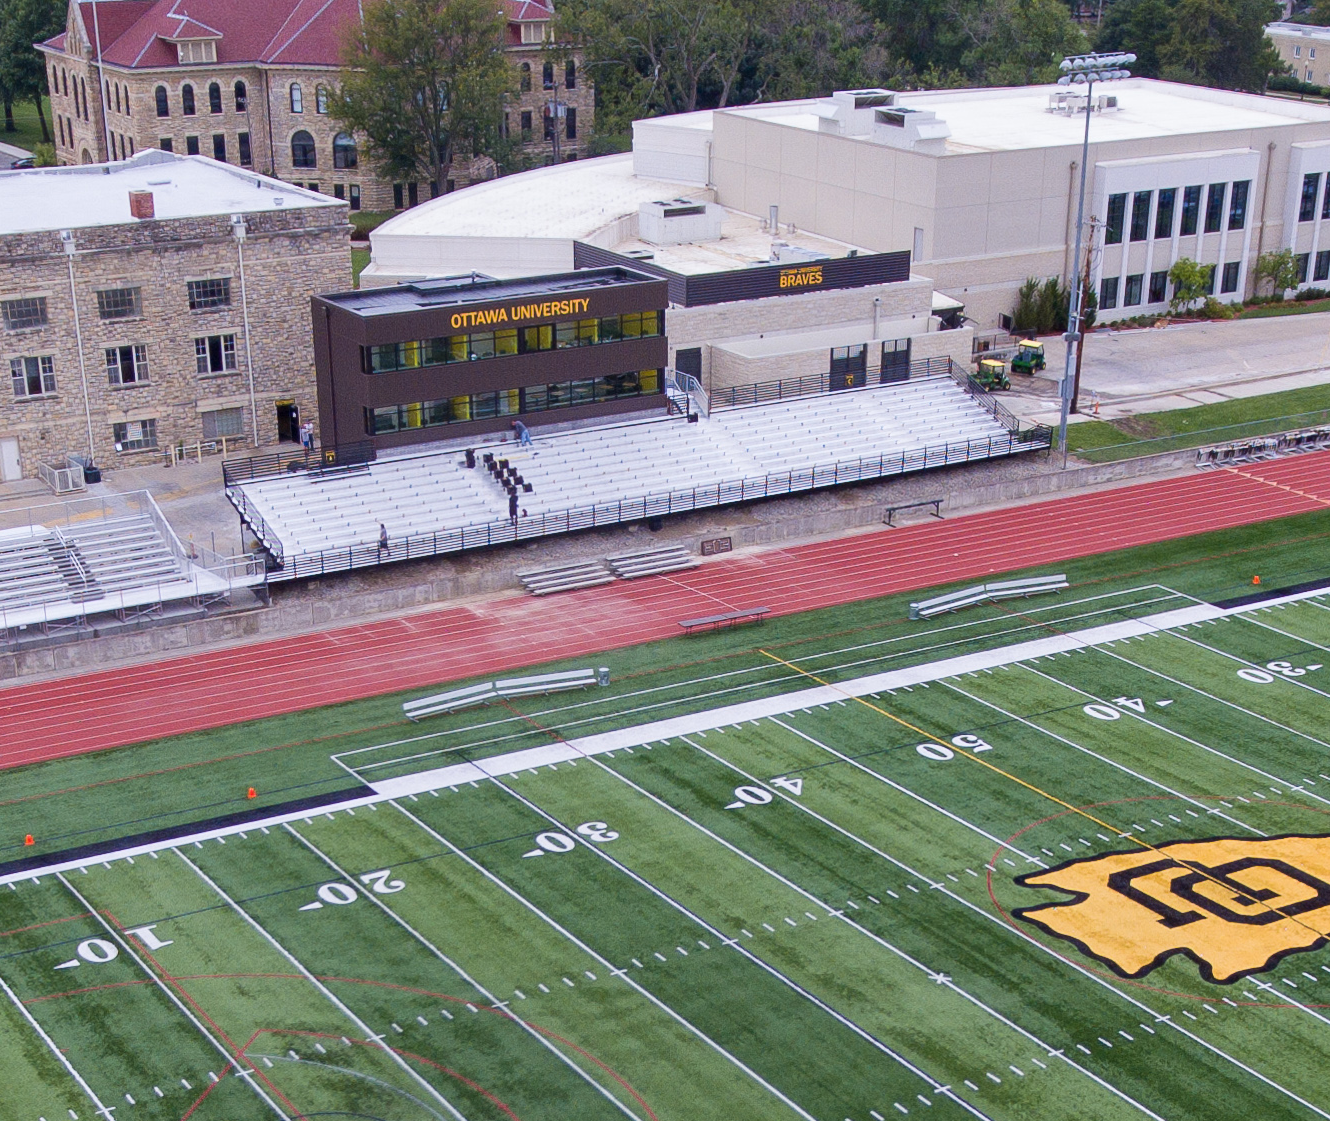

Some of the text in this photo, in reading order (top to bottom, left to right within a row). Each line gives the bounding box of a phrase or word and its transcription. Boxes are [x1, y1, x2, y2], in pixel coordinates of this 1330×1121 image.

[780, 271, 823, 288] BRAVES
[451, 298, 590, 329] OTTAWA UNIVERSITY
[1237, 661, 1307, 685] 30
[1082, 697, 1146, 721] 40
[916, 734, 992, 760] 50
[734, 776, 803, 807] 40
[535, 822, 619, 853] 30
[318, 870, 405, 906] 20
[78, 924, 174, 964] 10
